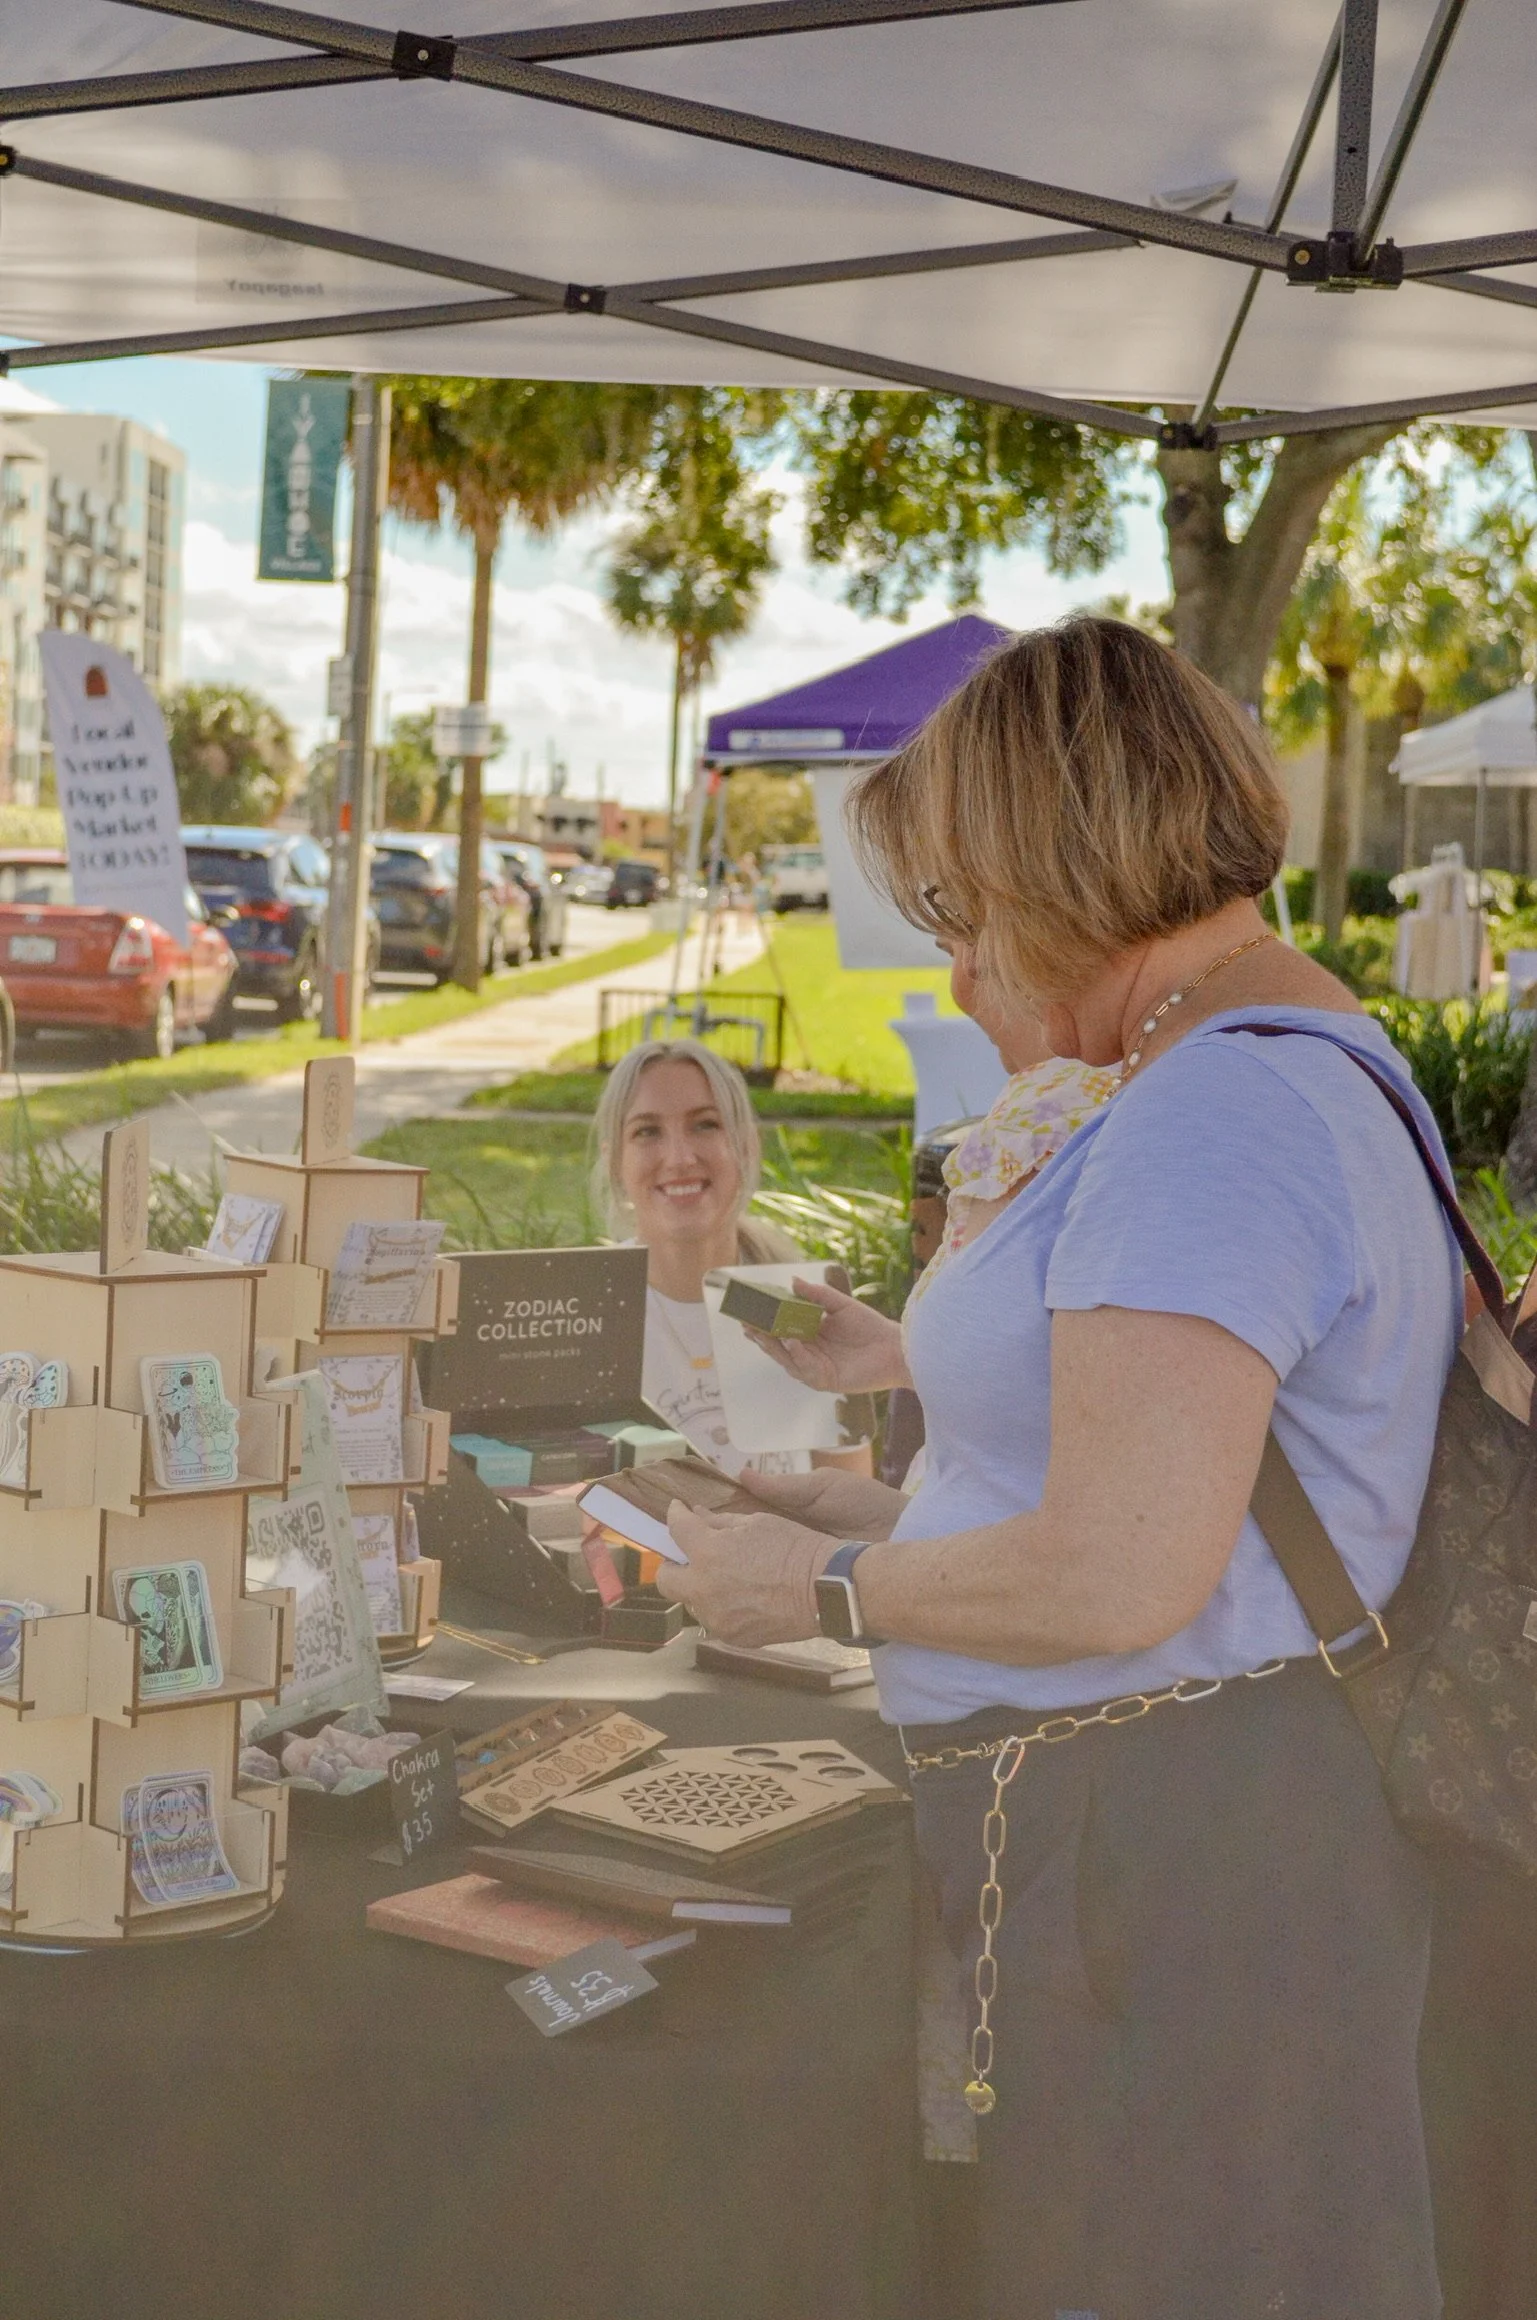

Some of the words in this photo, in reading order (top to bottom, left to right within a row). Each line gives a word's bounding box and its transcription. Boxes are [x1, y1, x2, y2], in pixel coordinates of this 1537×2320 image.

[503, 1298, 579, 1319] ZODIAC
[476, 1317, 602, 1342] COLLECTION
[553, 1347, 581, 1359] packs
[392, 1747, 441, 1784] Chakra
[410, 1778, 435, 1808] Set
[401, 1811, 433, 1856] $35
[525, 1974, 582, 2028] Journals
[570, 1969, 635, 2013] $35
